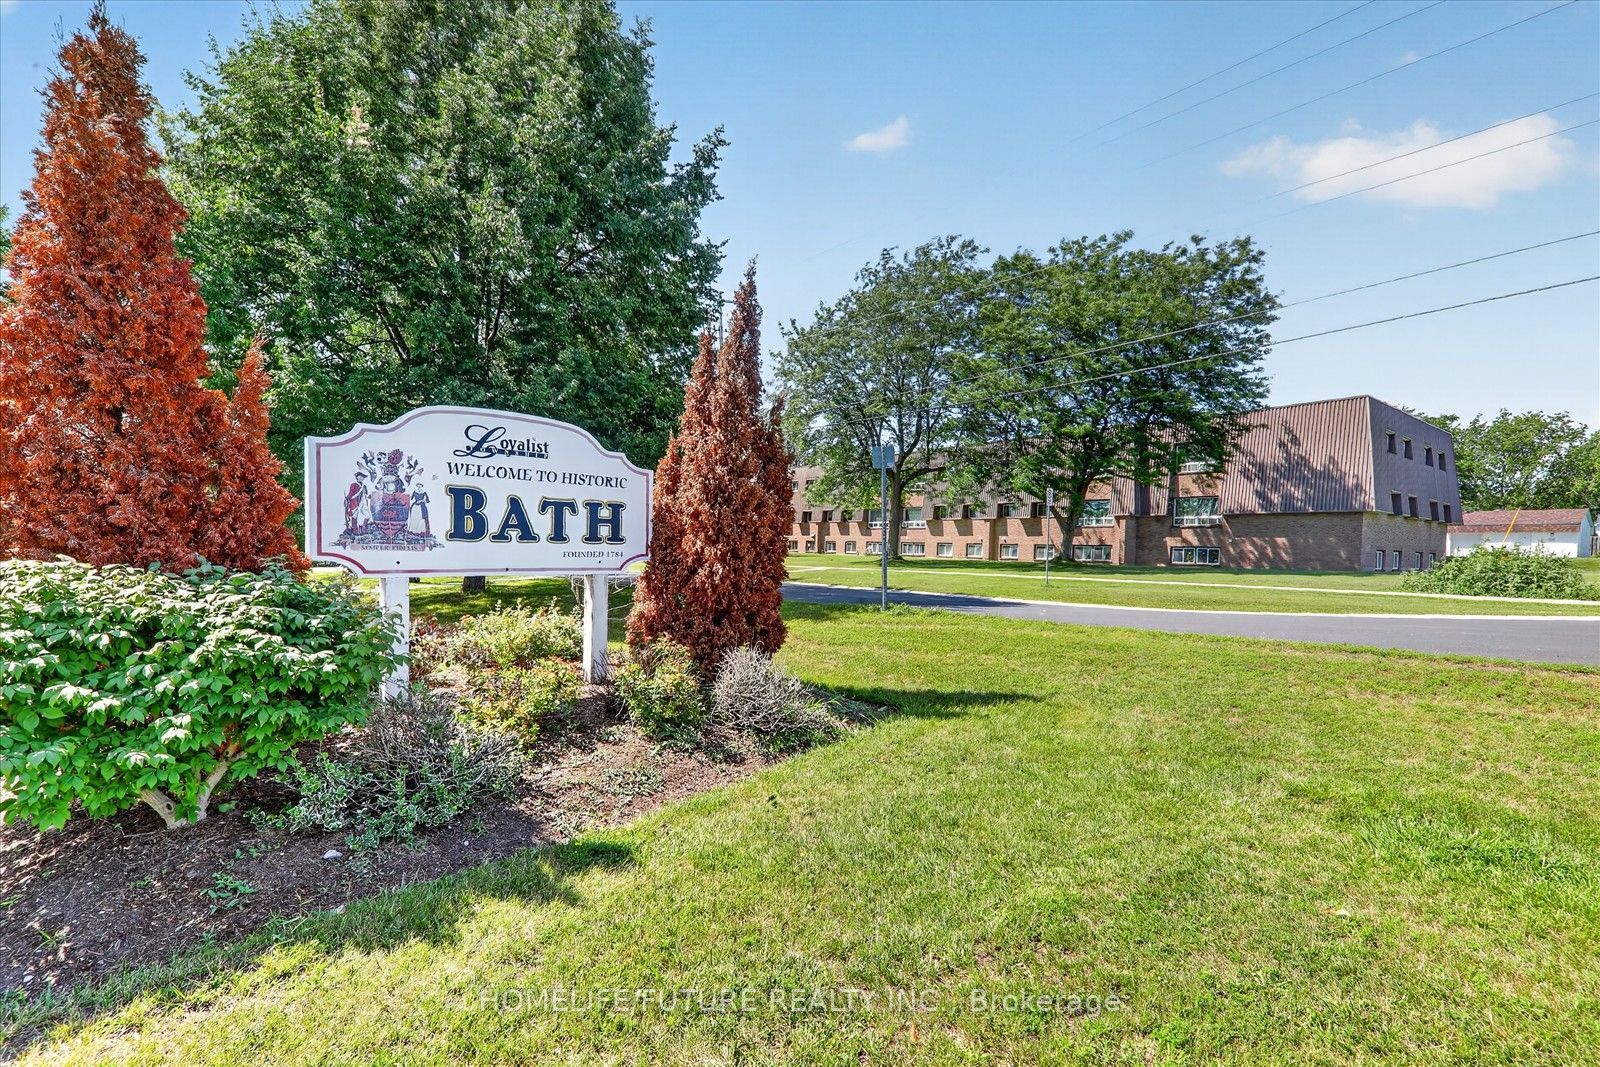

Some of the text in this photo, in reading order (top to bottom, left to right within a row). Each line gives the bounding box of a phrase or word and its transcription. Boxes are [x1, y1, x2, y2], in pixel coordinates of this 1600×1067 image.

[453, 424, 549, 459] Loyalist
[446, 462, 628, 489] WELCOME TO HISTORIC
[445, 484, 627, 545] BATH
